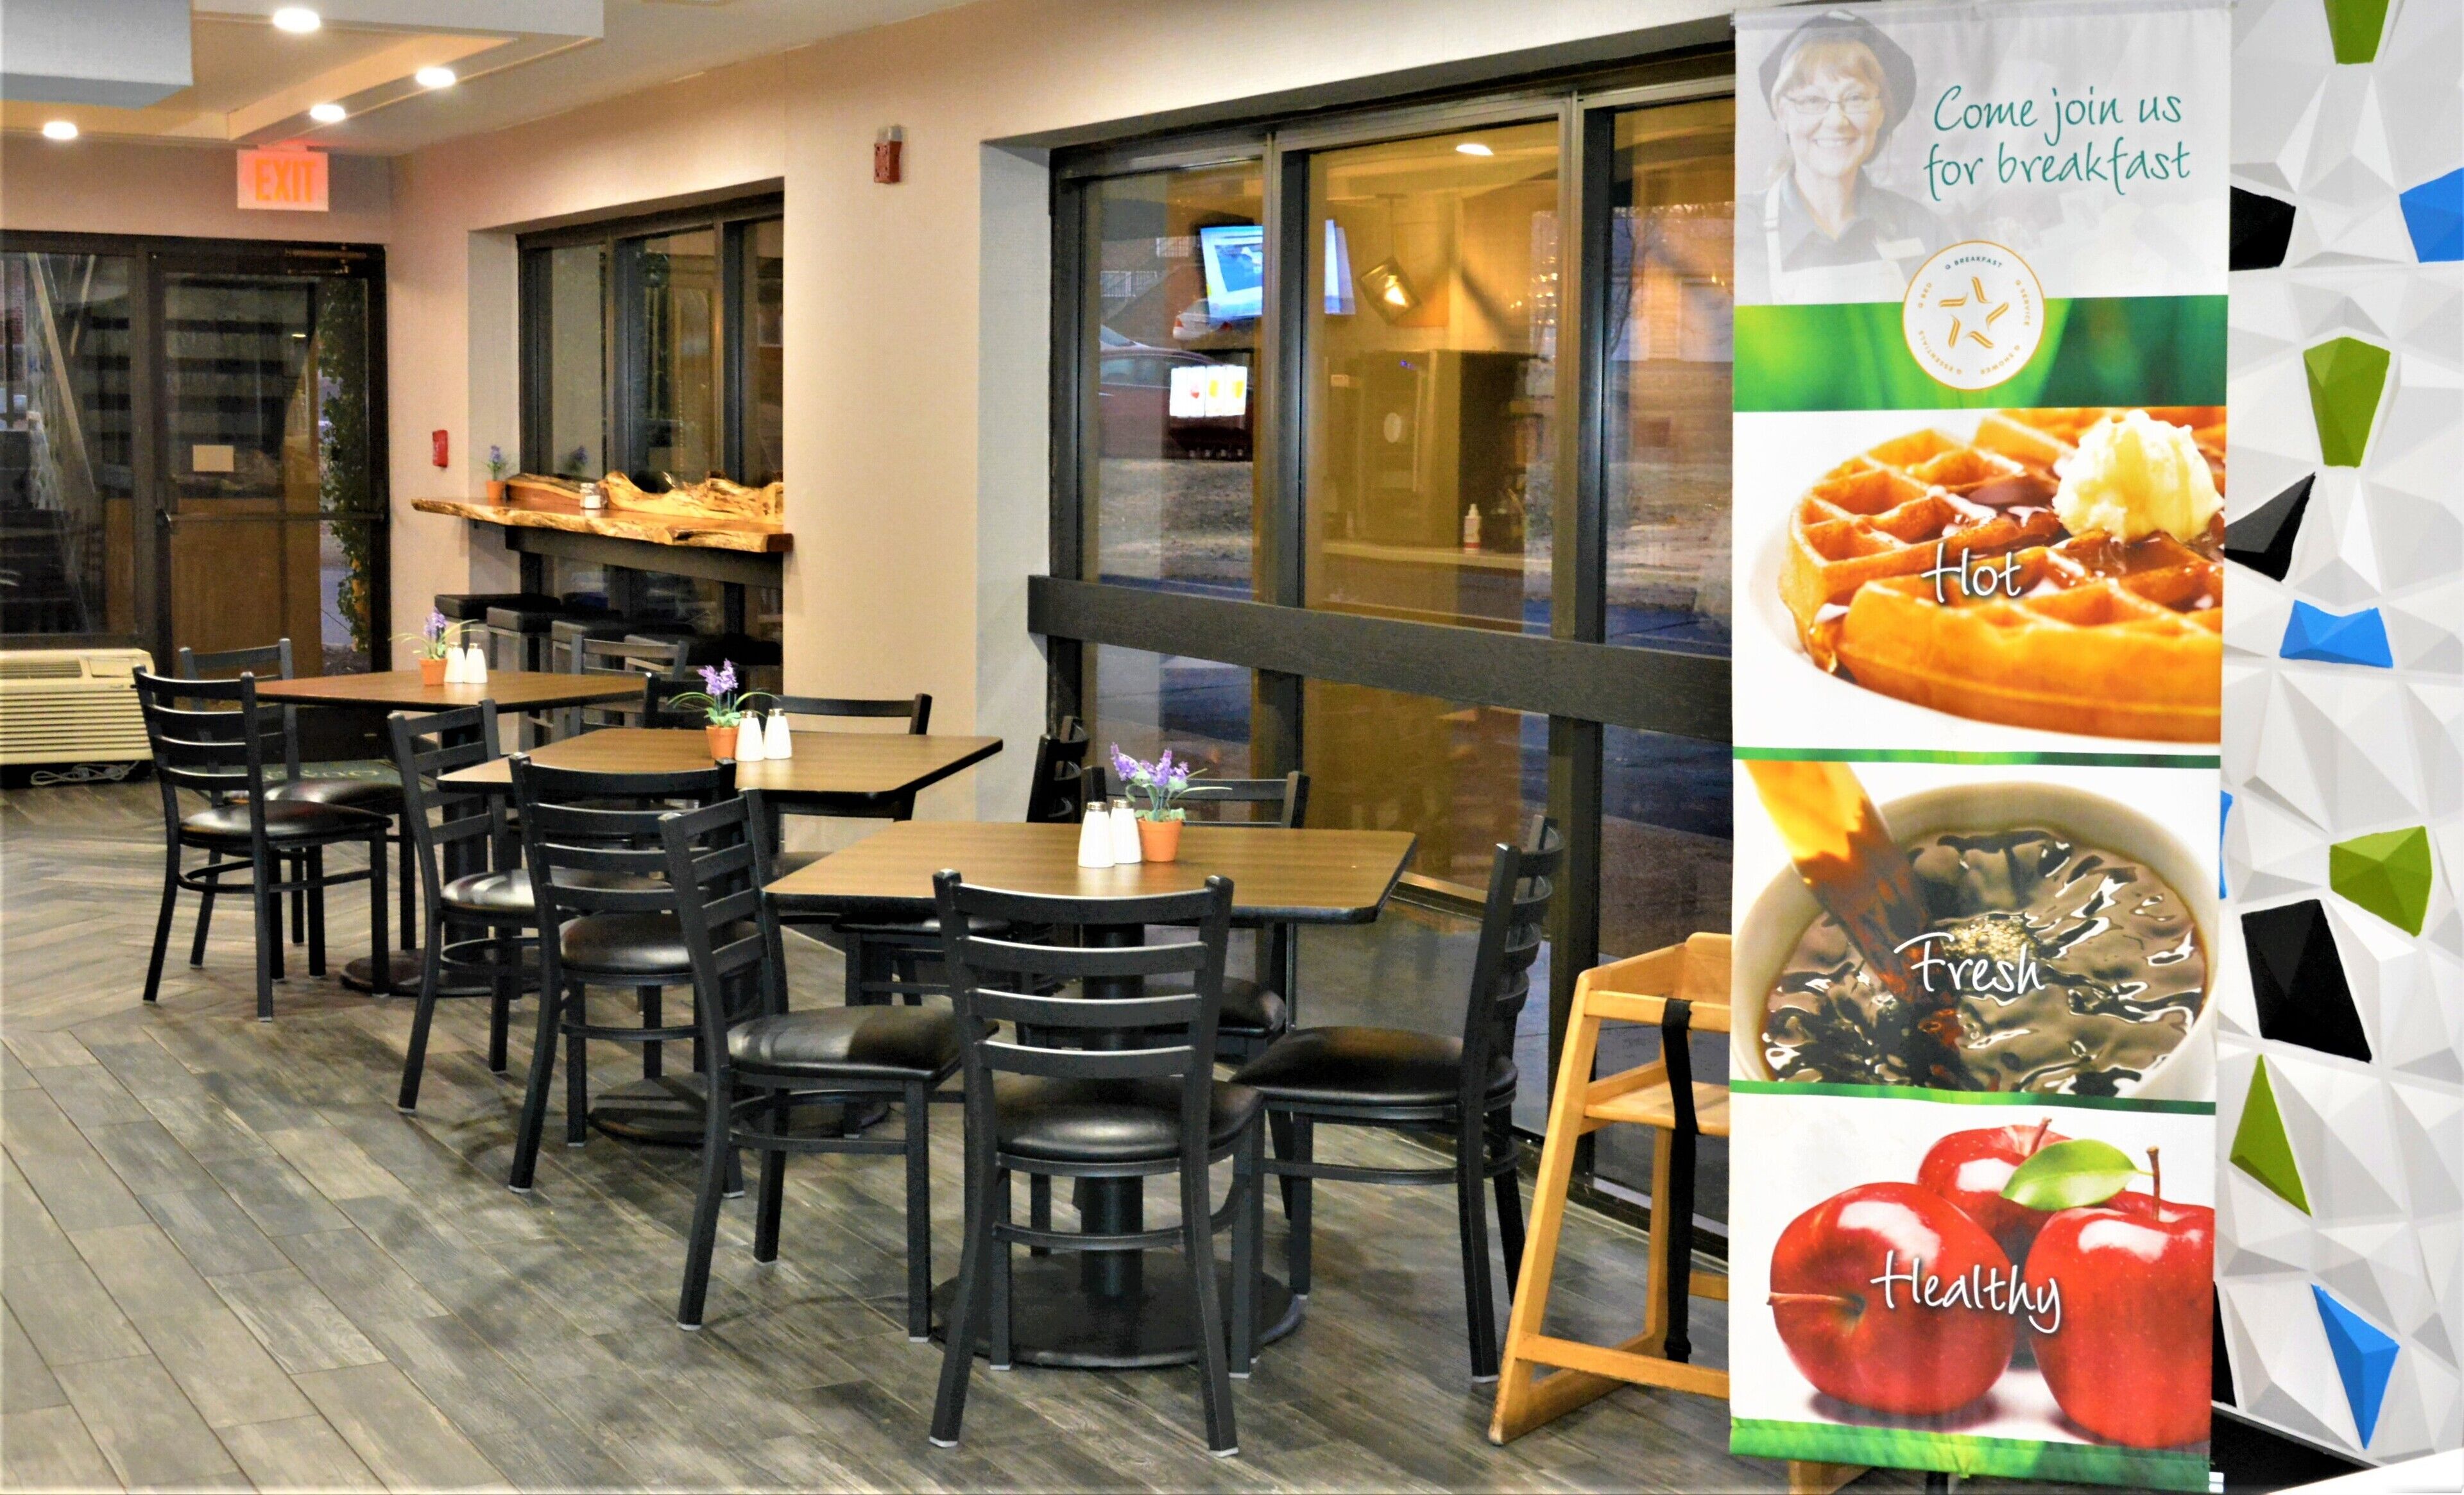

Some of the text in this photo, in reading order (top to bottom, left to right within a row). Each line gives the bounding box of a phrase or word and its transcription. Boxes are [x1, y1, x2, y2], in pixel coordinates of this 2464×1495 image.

[1933, 85, 2182, 146] Come join us
[255, 158, 316, 202] EXIT
[1923, 137, 2191, 201] for breakfast
[1954, 256, 2003, 268] BREAKFAST
[2021, 288, 2031, 326] SERVICE
[1919, 330, 1953, 372] ESSENTIALS
[1980, 352, 2014, 375] SHOWER
[1920, 542, 2021, 603] Hot
[1894, 932, 2046, 994] Fresh
[1870, 1249, 2061, 1333] Healthy
